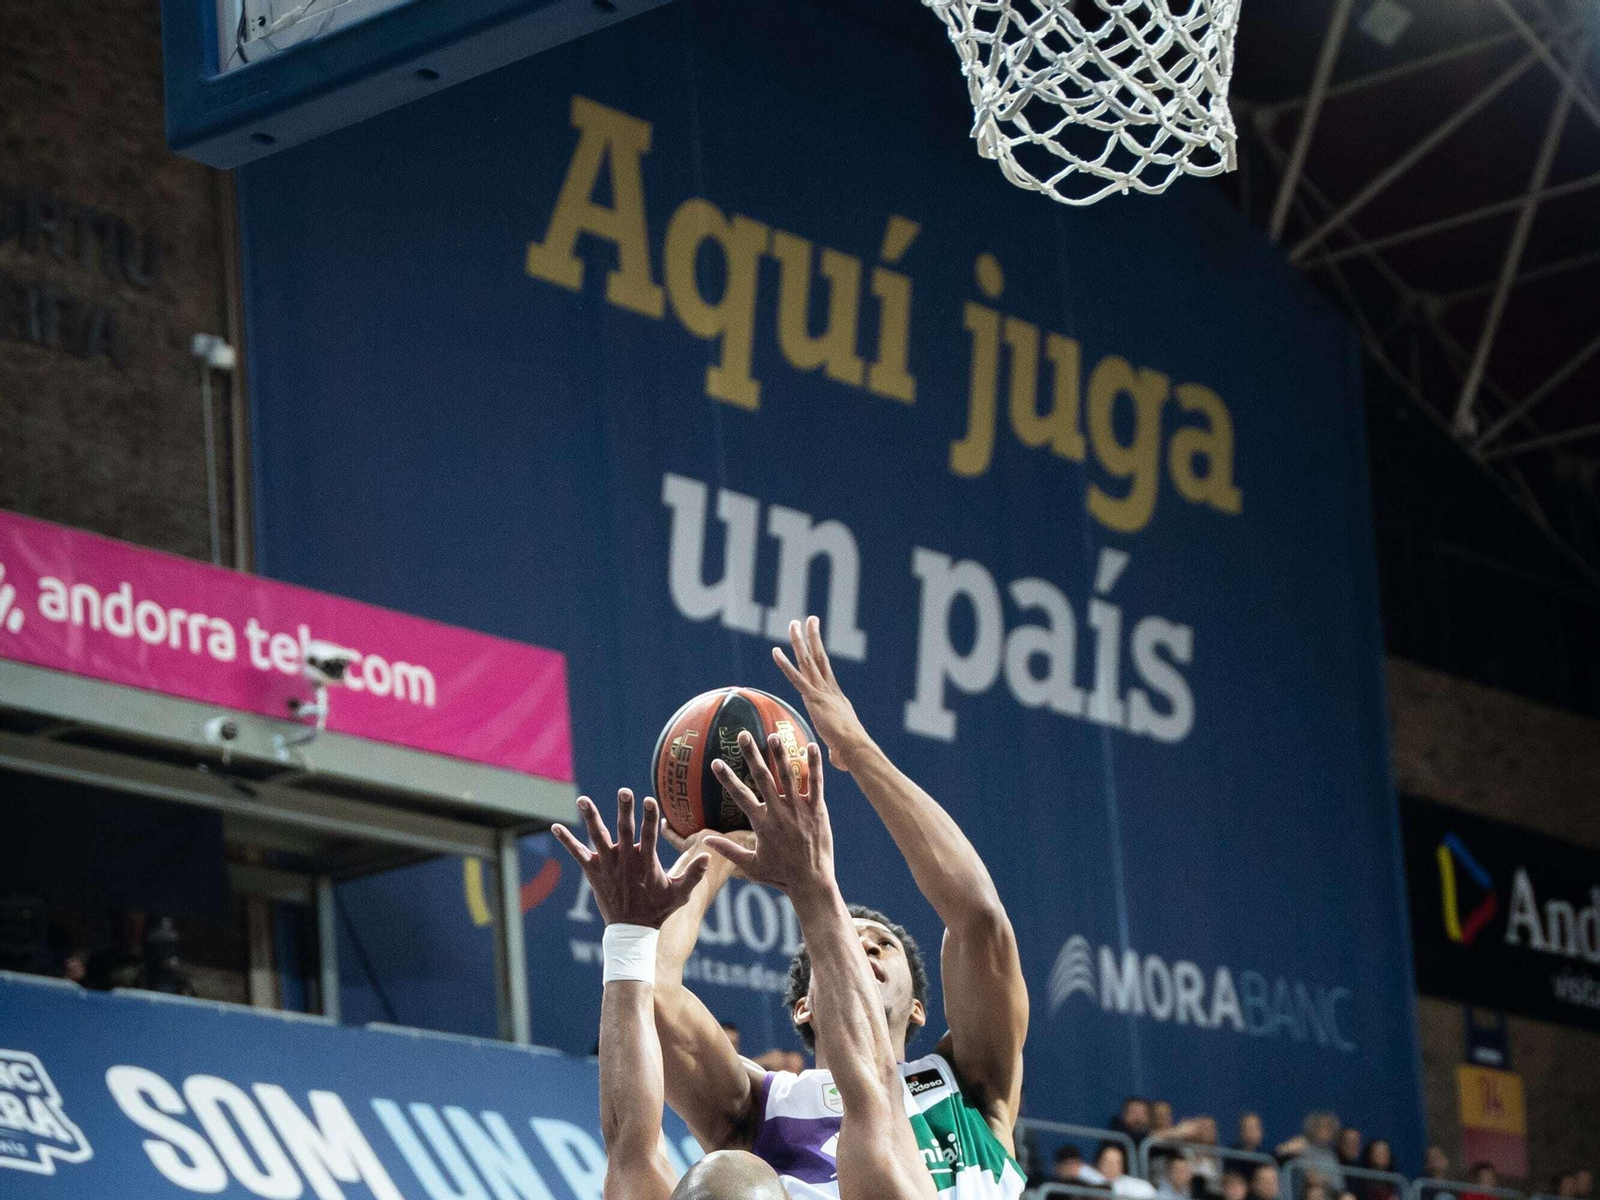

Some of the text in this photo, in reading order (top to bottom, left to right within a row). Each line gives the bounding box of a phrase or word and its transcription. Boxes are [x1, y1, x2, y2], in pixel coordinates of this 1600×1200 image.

[525, 94, 1242, 533] Aquí juga
[38, 576, 437, 707] andorra telcom
[661, 472, 1196, 744] un país
[675, 729, 699, 829] LEGACY
